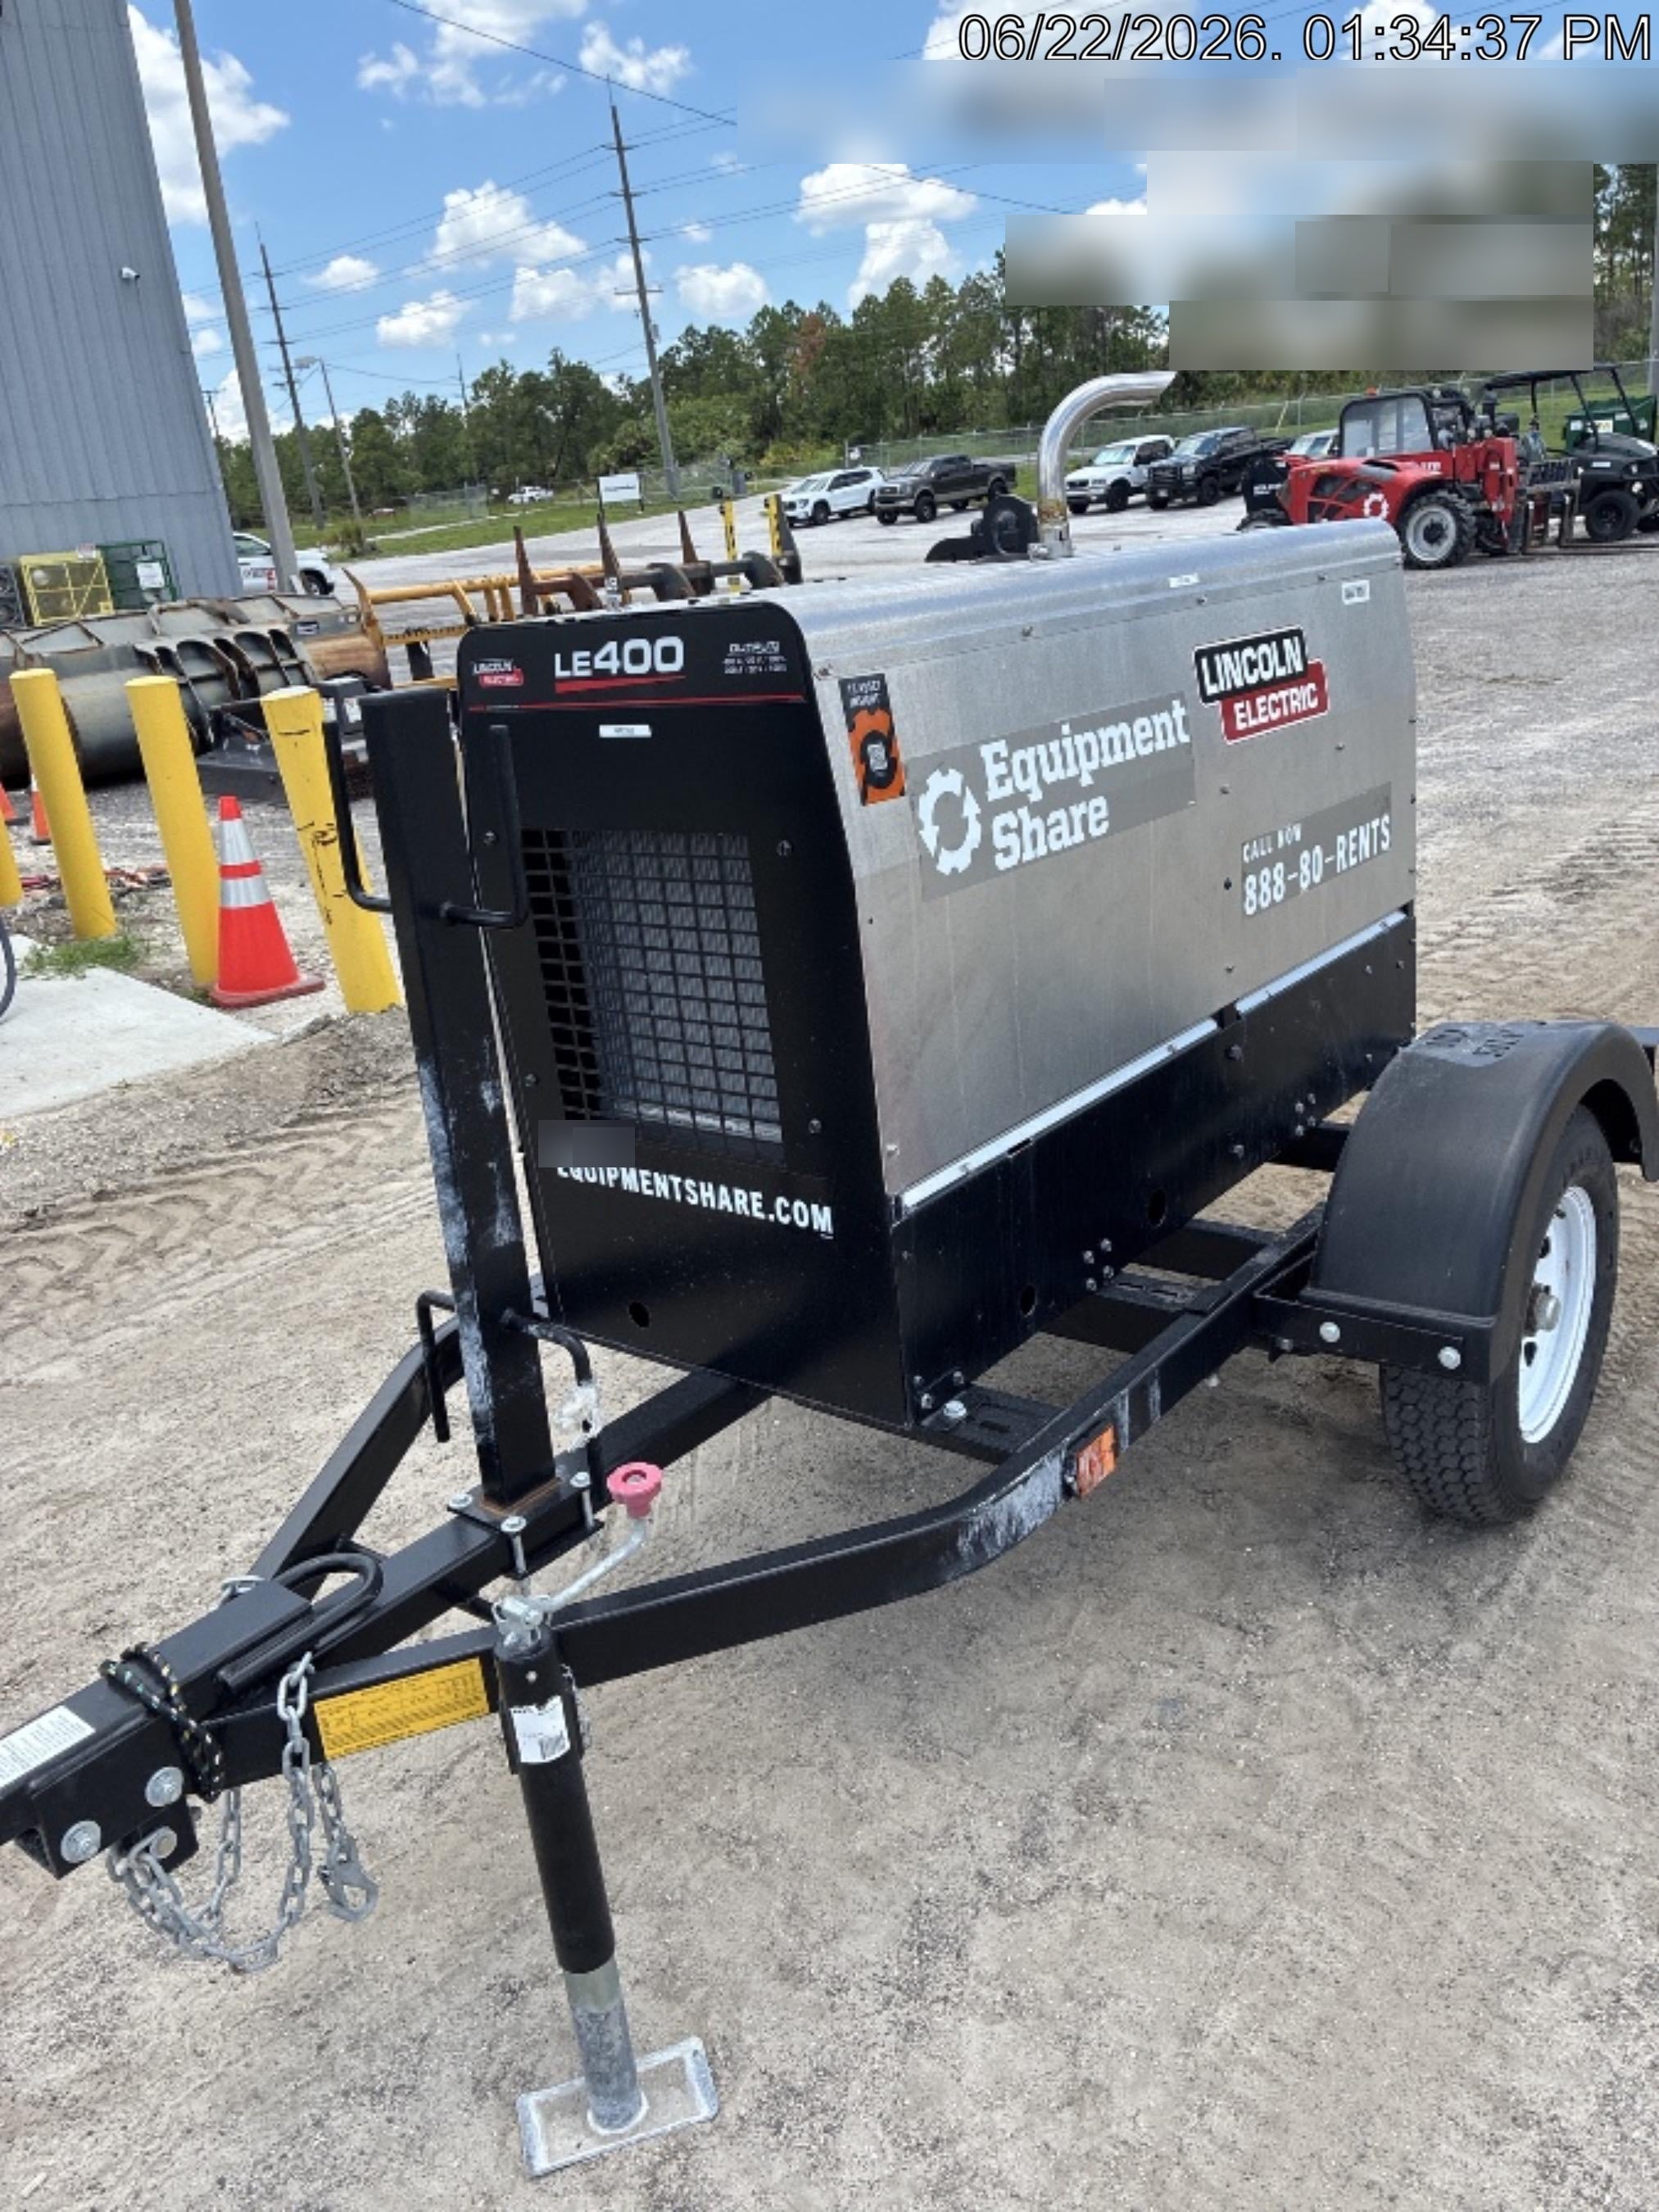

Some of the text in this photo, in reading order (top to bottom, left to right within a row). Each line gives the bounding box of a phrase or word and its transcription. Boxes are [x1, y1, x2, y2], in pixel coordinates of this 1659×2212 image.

[555, 636, 684, 678] LE400
[1200, 635, 1303, 696] LINCOLN
[1234, 681, 1319, 730] ELECTRIC
[979, 699, 1190, 803] Equipment
[992, 796, 1109, 872] Share
[1243, 823, 1303, 863] CALL NOW
[1244, 813, 1391, 916] 888-80-RENTS
